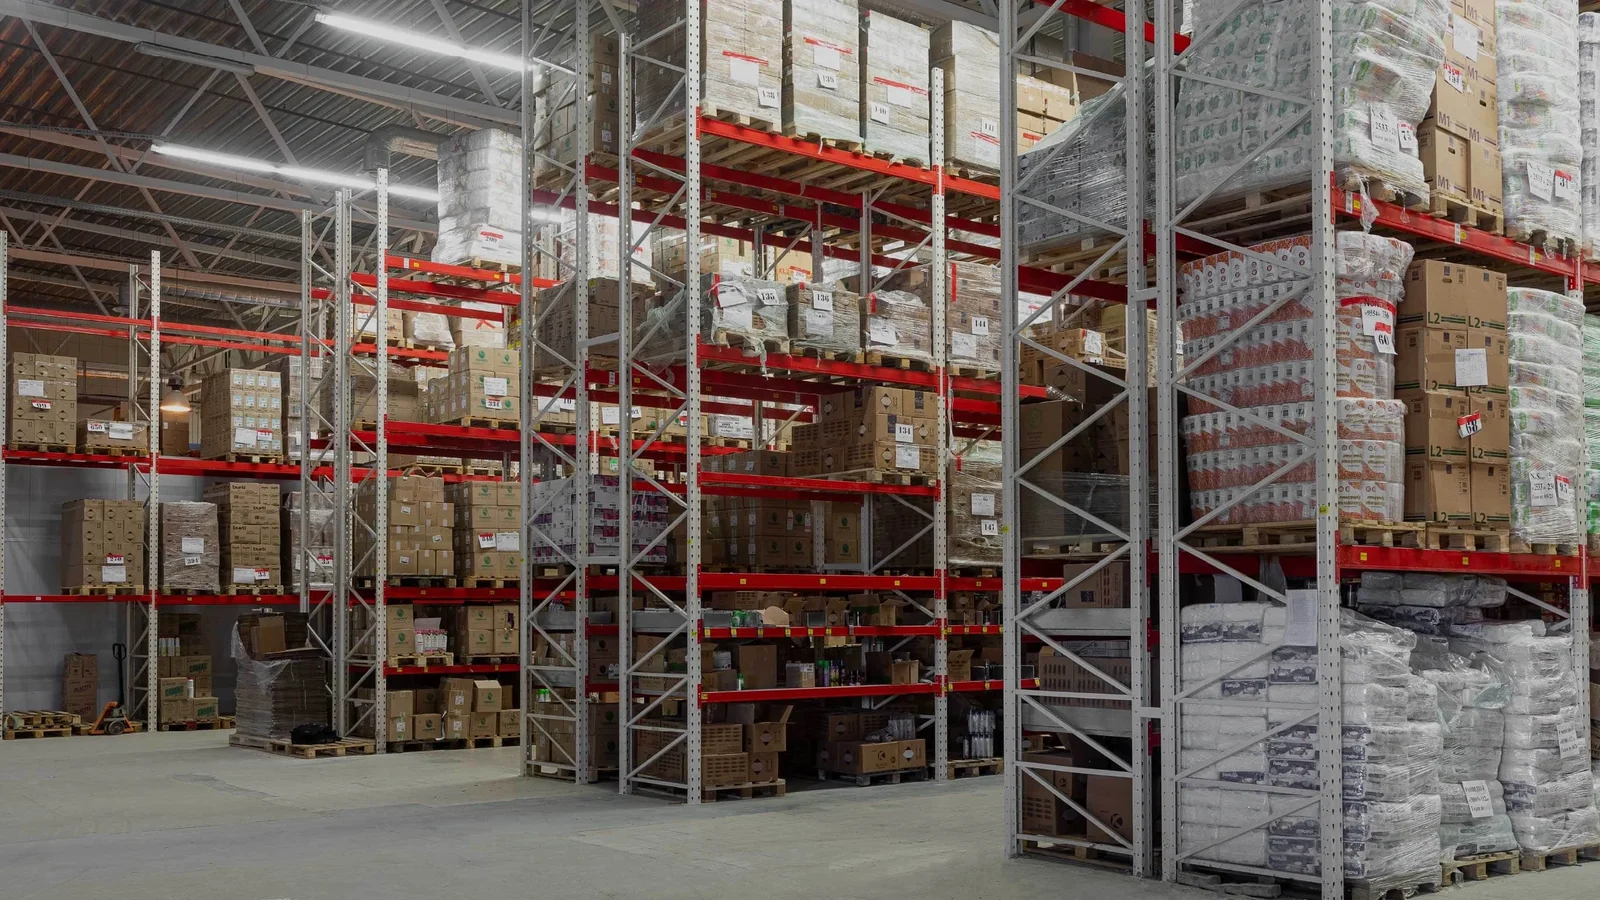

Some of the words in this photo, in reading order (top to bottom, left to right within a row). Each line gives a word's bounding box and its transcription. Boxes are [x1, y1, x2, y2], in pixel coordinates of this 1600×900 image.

[1428, 312, 1440, 324] L2
[1468, 316, 1481, 328] L2
[1430, 445, 1442, 458] L2
[1472, 447, 1484, 459] L2
[1474, 512, 1487, 524] L2
